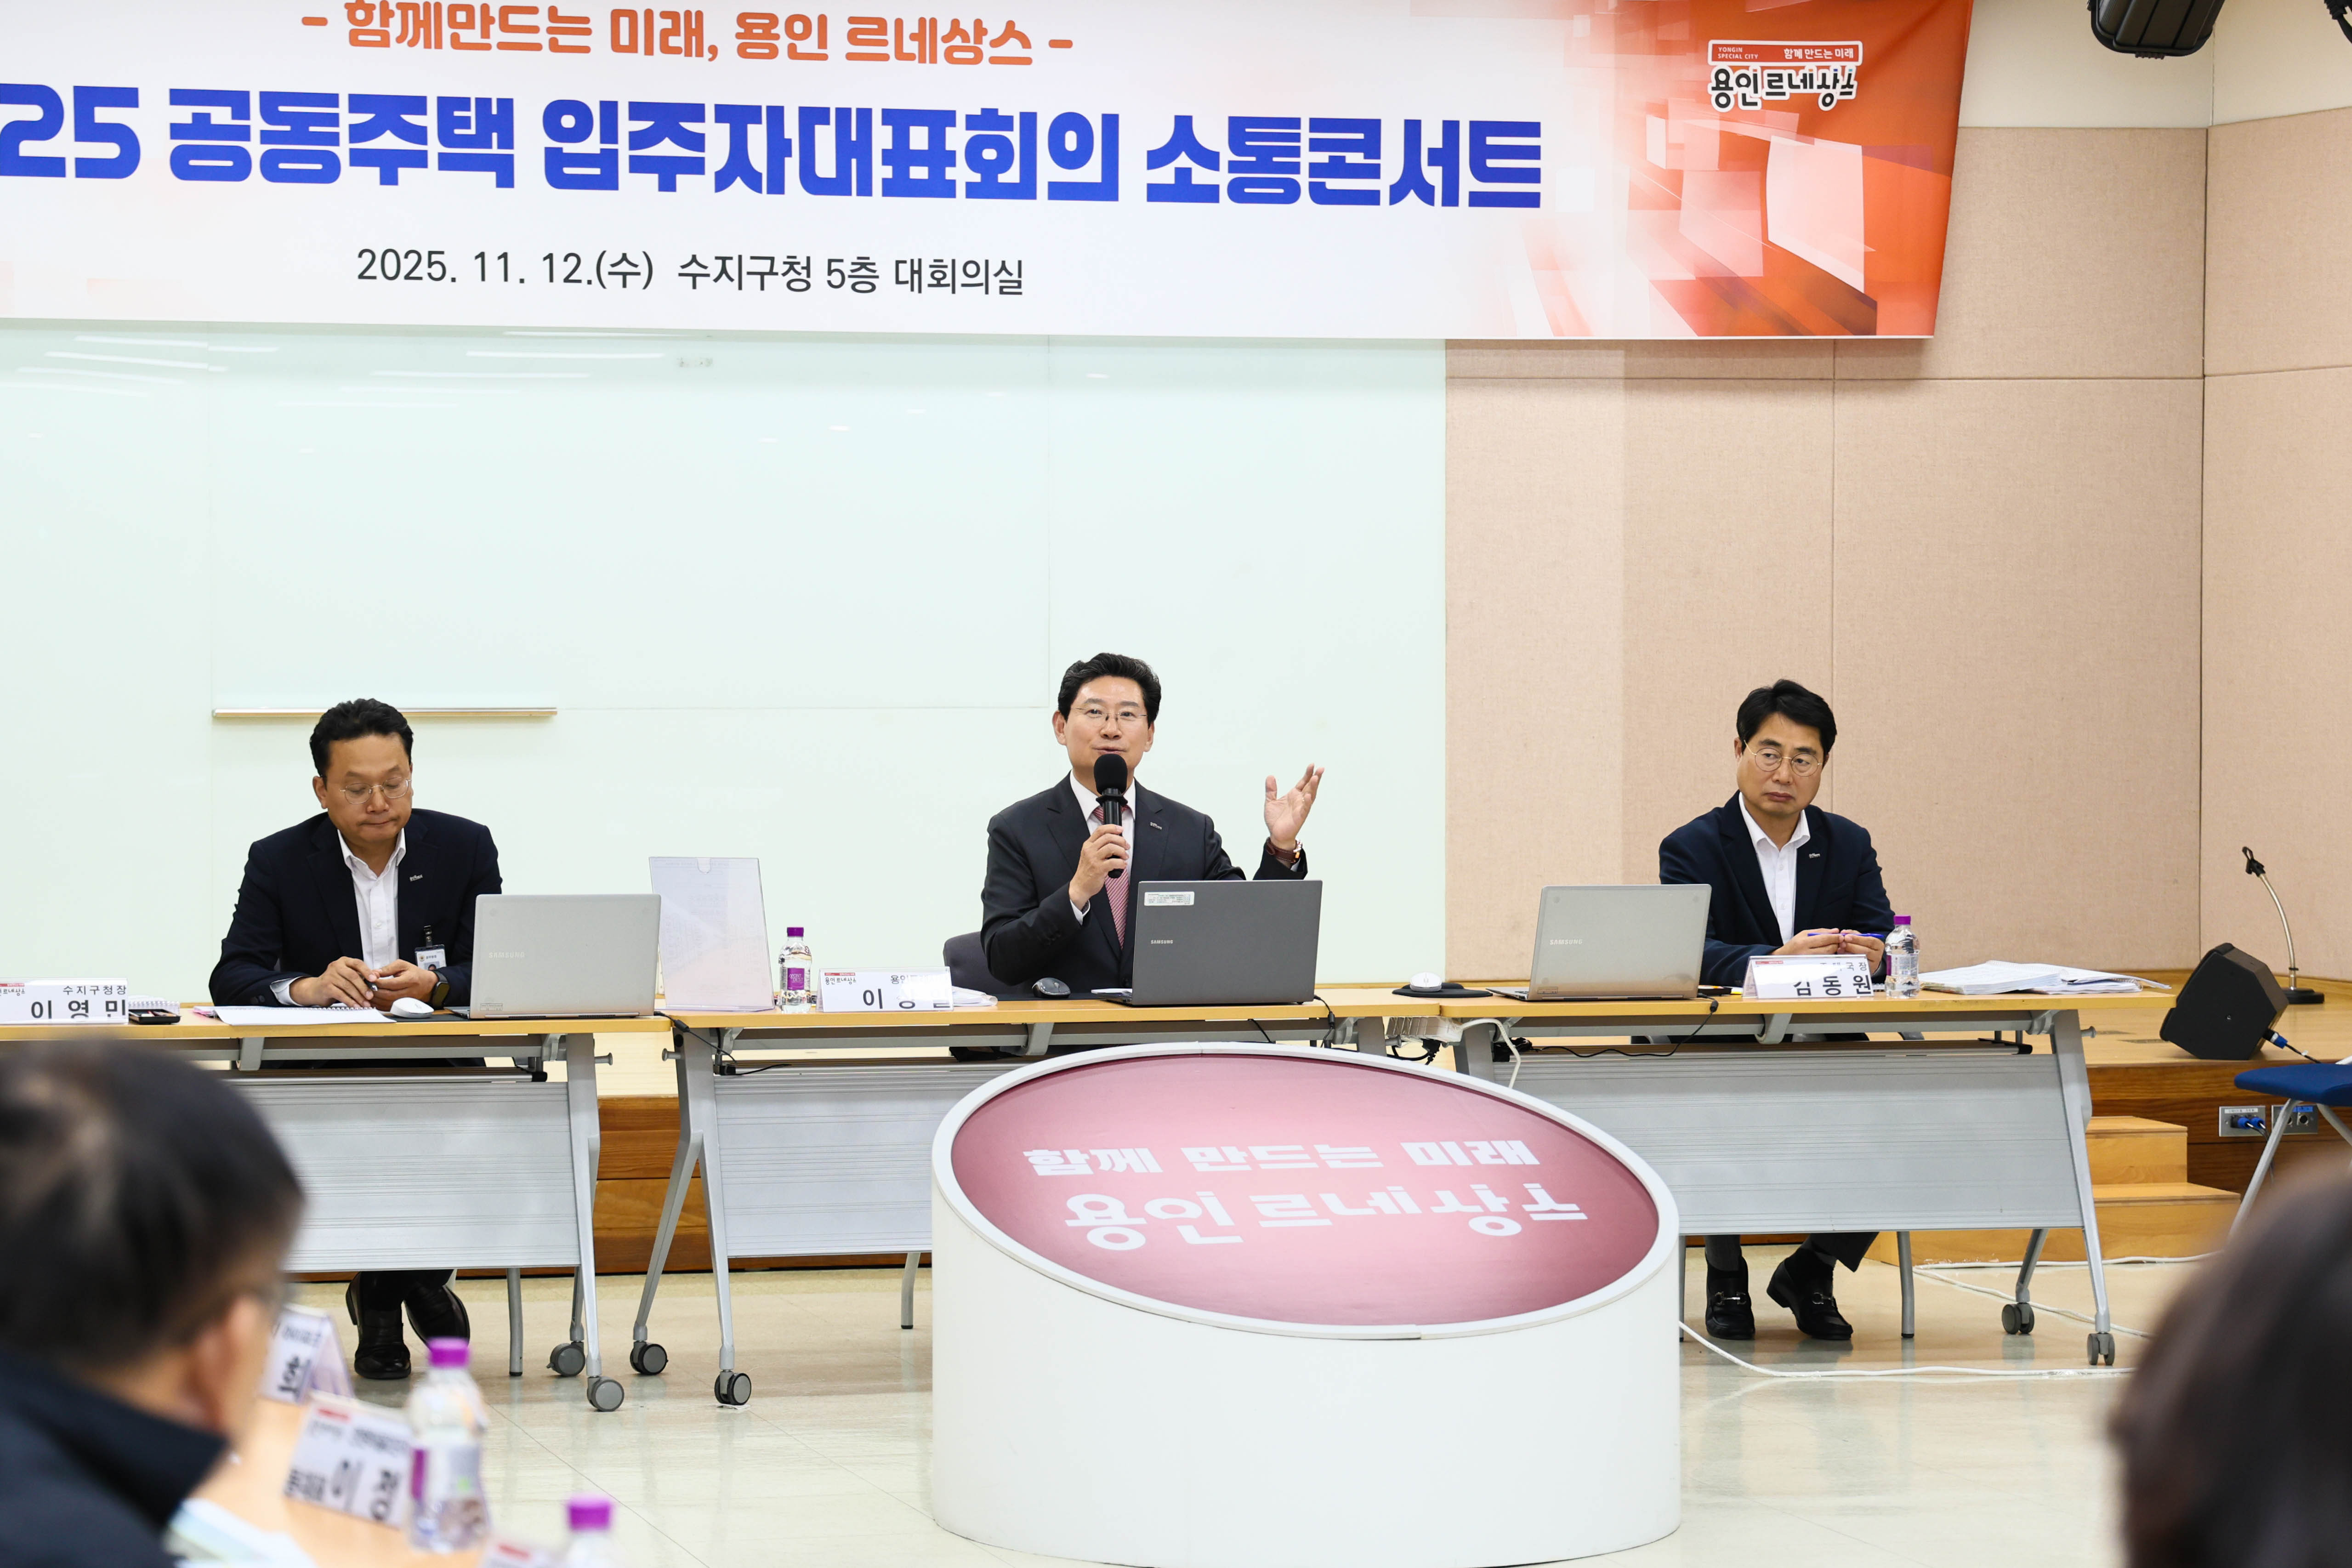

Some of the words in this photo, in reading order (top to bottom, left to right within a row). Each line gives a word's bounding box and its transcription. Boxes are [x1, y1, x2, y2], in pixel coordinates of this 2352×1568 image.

[344, 1, 592, 54] 함께만드는
[610, 8, 719, 62] 미래,
[734, 12, 829, 62] 용인
[845, 16, 1034, 66] 르네상스
[1784, 48, 1803, 59] 함께
[1804, 48, 1833, 59] 만드는
[1835, 48, 1854, 59] 미래
[1711, 68, 1758, 108] 용인
[1765, 68, 1854, 107] 르네상스
[169, 87, 515, 189] 공동주택
[543, 99, 1119, 202] 입주자대표회의
[1146, 114, 1541, 208] 소통콘서트
[357, 248, 457, 283] 2025.
[474, 251, 525, 284] 11.
[542, 250, 653, 290] 12.(수)
[678, 254, 812, 293] 수지구청
[827, 256, 880, 294] 5층
[895, 258, 1023, 296] 대회의실
[63, 985, 127, 995] 수지구청장
[1023, 1148, 1164, 1176] 함께
[1180, 1144, 1385, 1172] 만드는
[1400, 1140, 1540, 1166] 미래
[1064, 1191, 1244, 1251] 용인
[1248, 1183, 1588, 1237] 르네상스
